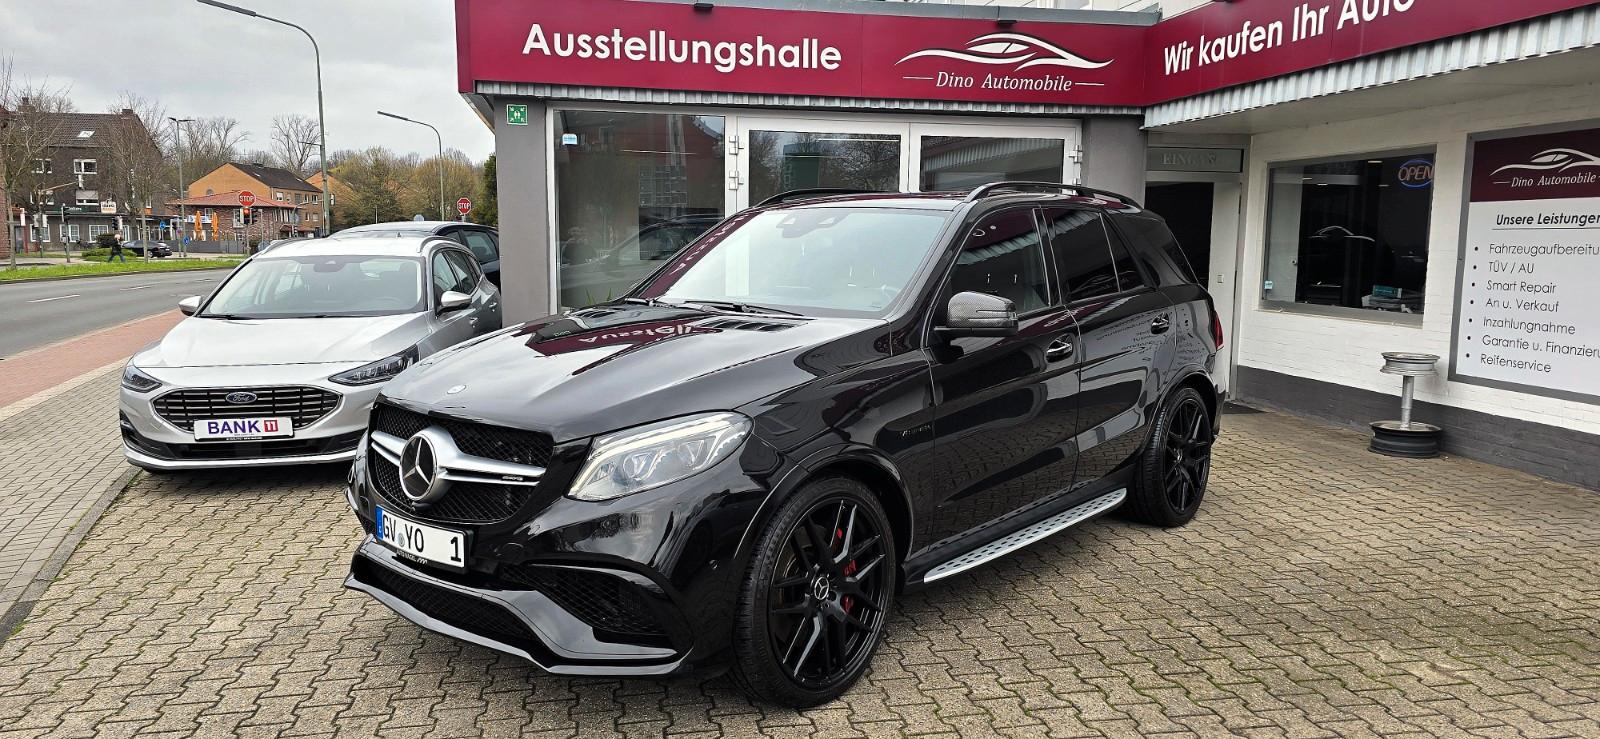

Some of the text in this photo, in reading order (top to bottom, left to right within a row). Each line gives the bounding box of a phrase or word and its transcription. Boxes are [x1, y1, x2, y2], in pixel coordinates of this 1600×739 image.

[1164, 40, 1194, 76] Wir
[1198, 20, 1283, 67] kaufen
[1292, 3, 1330, 42] Ihr
[522, 23, 842, 73] Ausstellungshalle
[936, 71, 1072, 91] Dino Automobile
[1398, 165, 1434, 181] OPEN
[1511, 172, 1596, 187] Dino Automobile
[1496, 214, 1534, 225] Unsere
[1489, 243, 1600, 257] Fahrzeugaufbereitu
[1488, 260, 1535, 274] TÜV / AU
[1486, 280, 1557, 294] Smart Repair
[1485, 298, 1559, 313] An u. Verkauf
[1483, 316, 1576, 335] Inzahlungnahme
[1482, 334, 1600, 359] Garantie u. Finanzier
[1480, 353, 1552, 373] Reifenservice
[207, 419, 278, 435] BANK 11
[383, 514, 462, 563] GV YO 1
